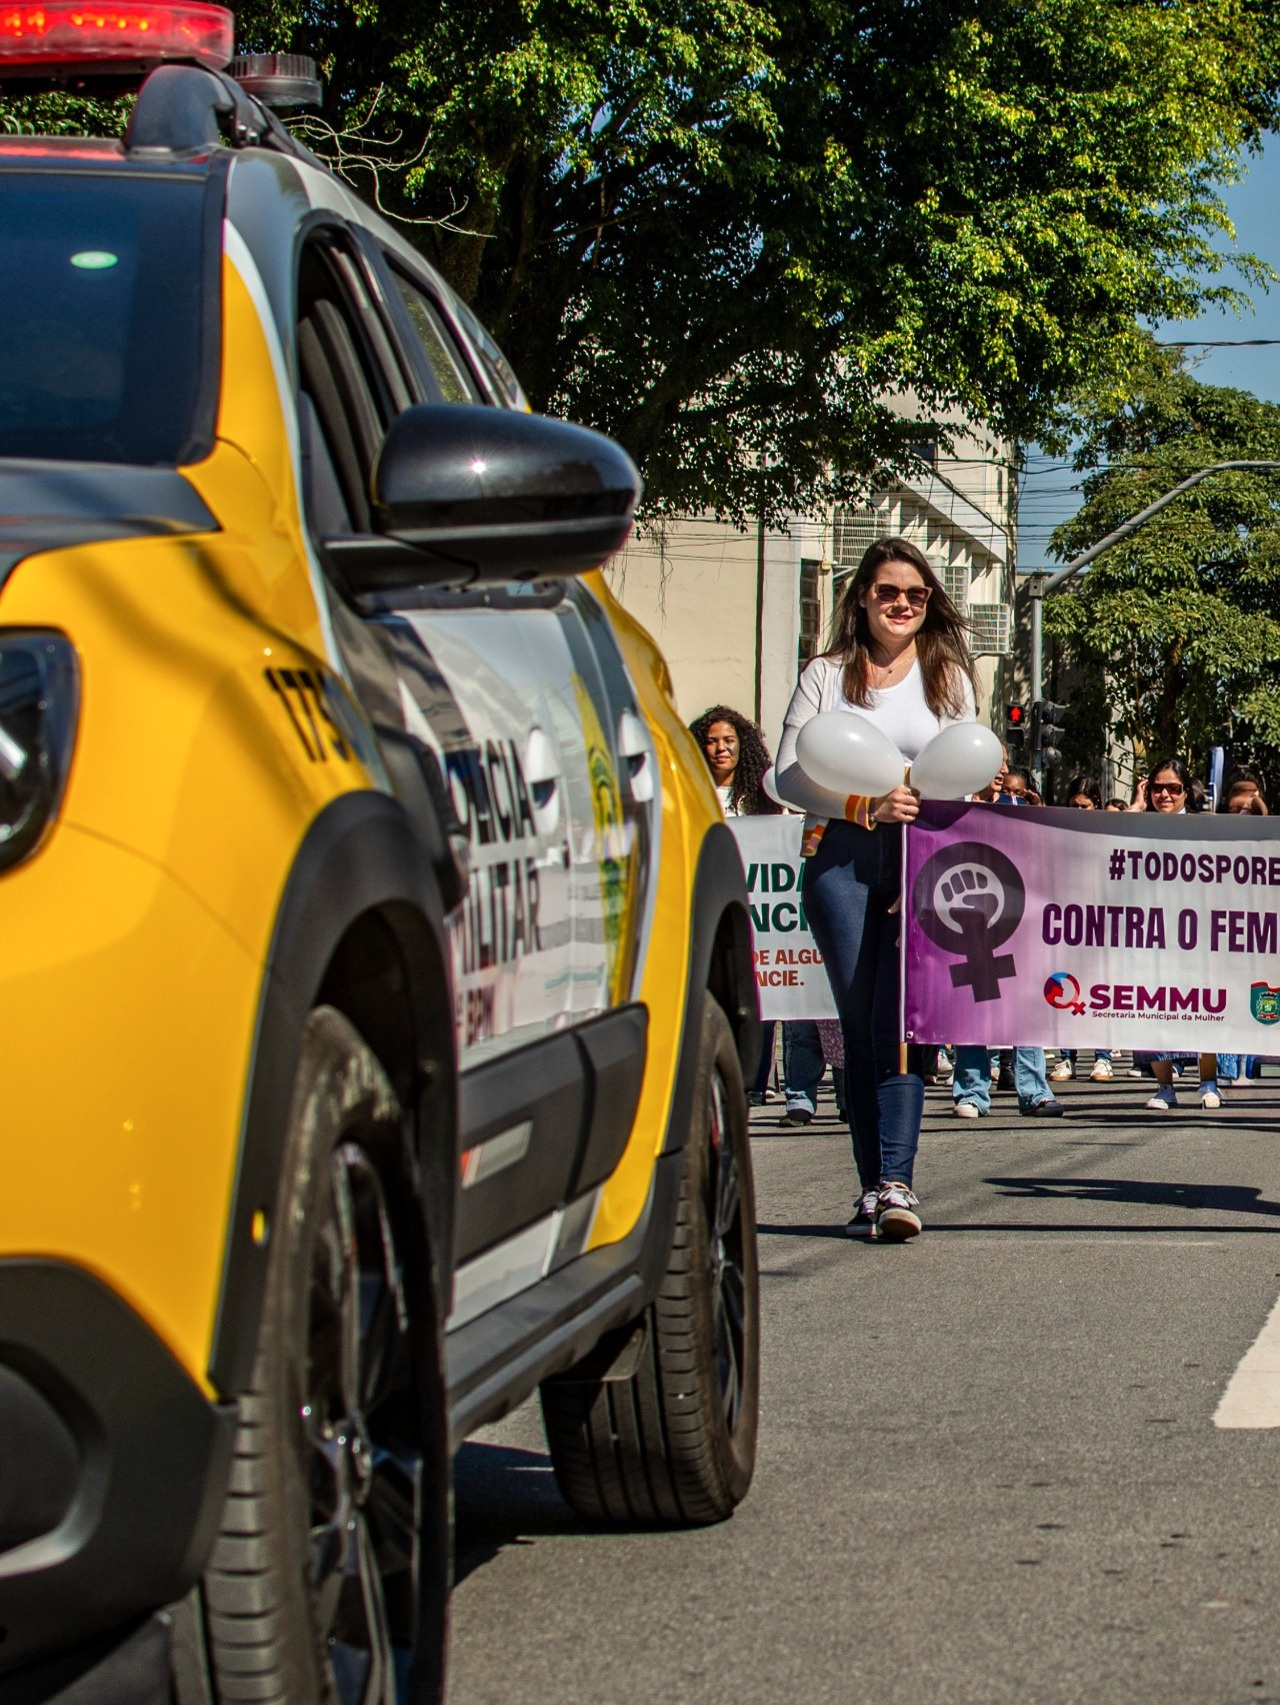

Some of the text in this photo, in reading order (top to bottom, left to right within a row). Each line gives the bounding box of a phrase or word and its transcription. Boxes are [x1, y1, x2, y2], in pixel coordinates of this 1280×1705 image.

[1042, 903, 1166, 949] CONTRA
[1177, 908, 1198, 950] O
[775, 949, 824, 964] ALGU
[754, 970, 805, 986] NCIE.
[1089, 984, 1227, 1014] SEMMU
[1092, 1010, 1225, 1022] Secretaria Municipal da Mulher
